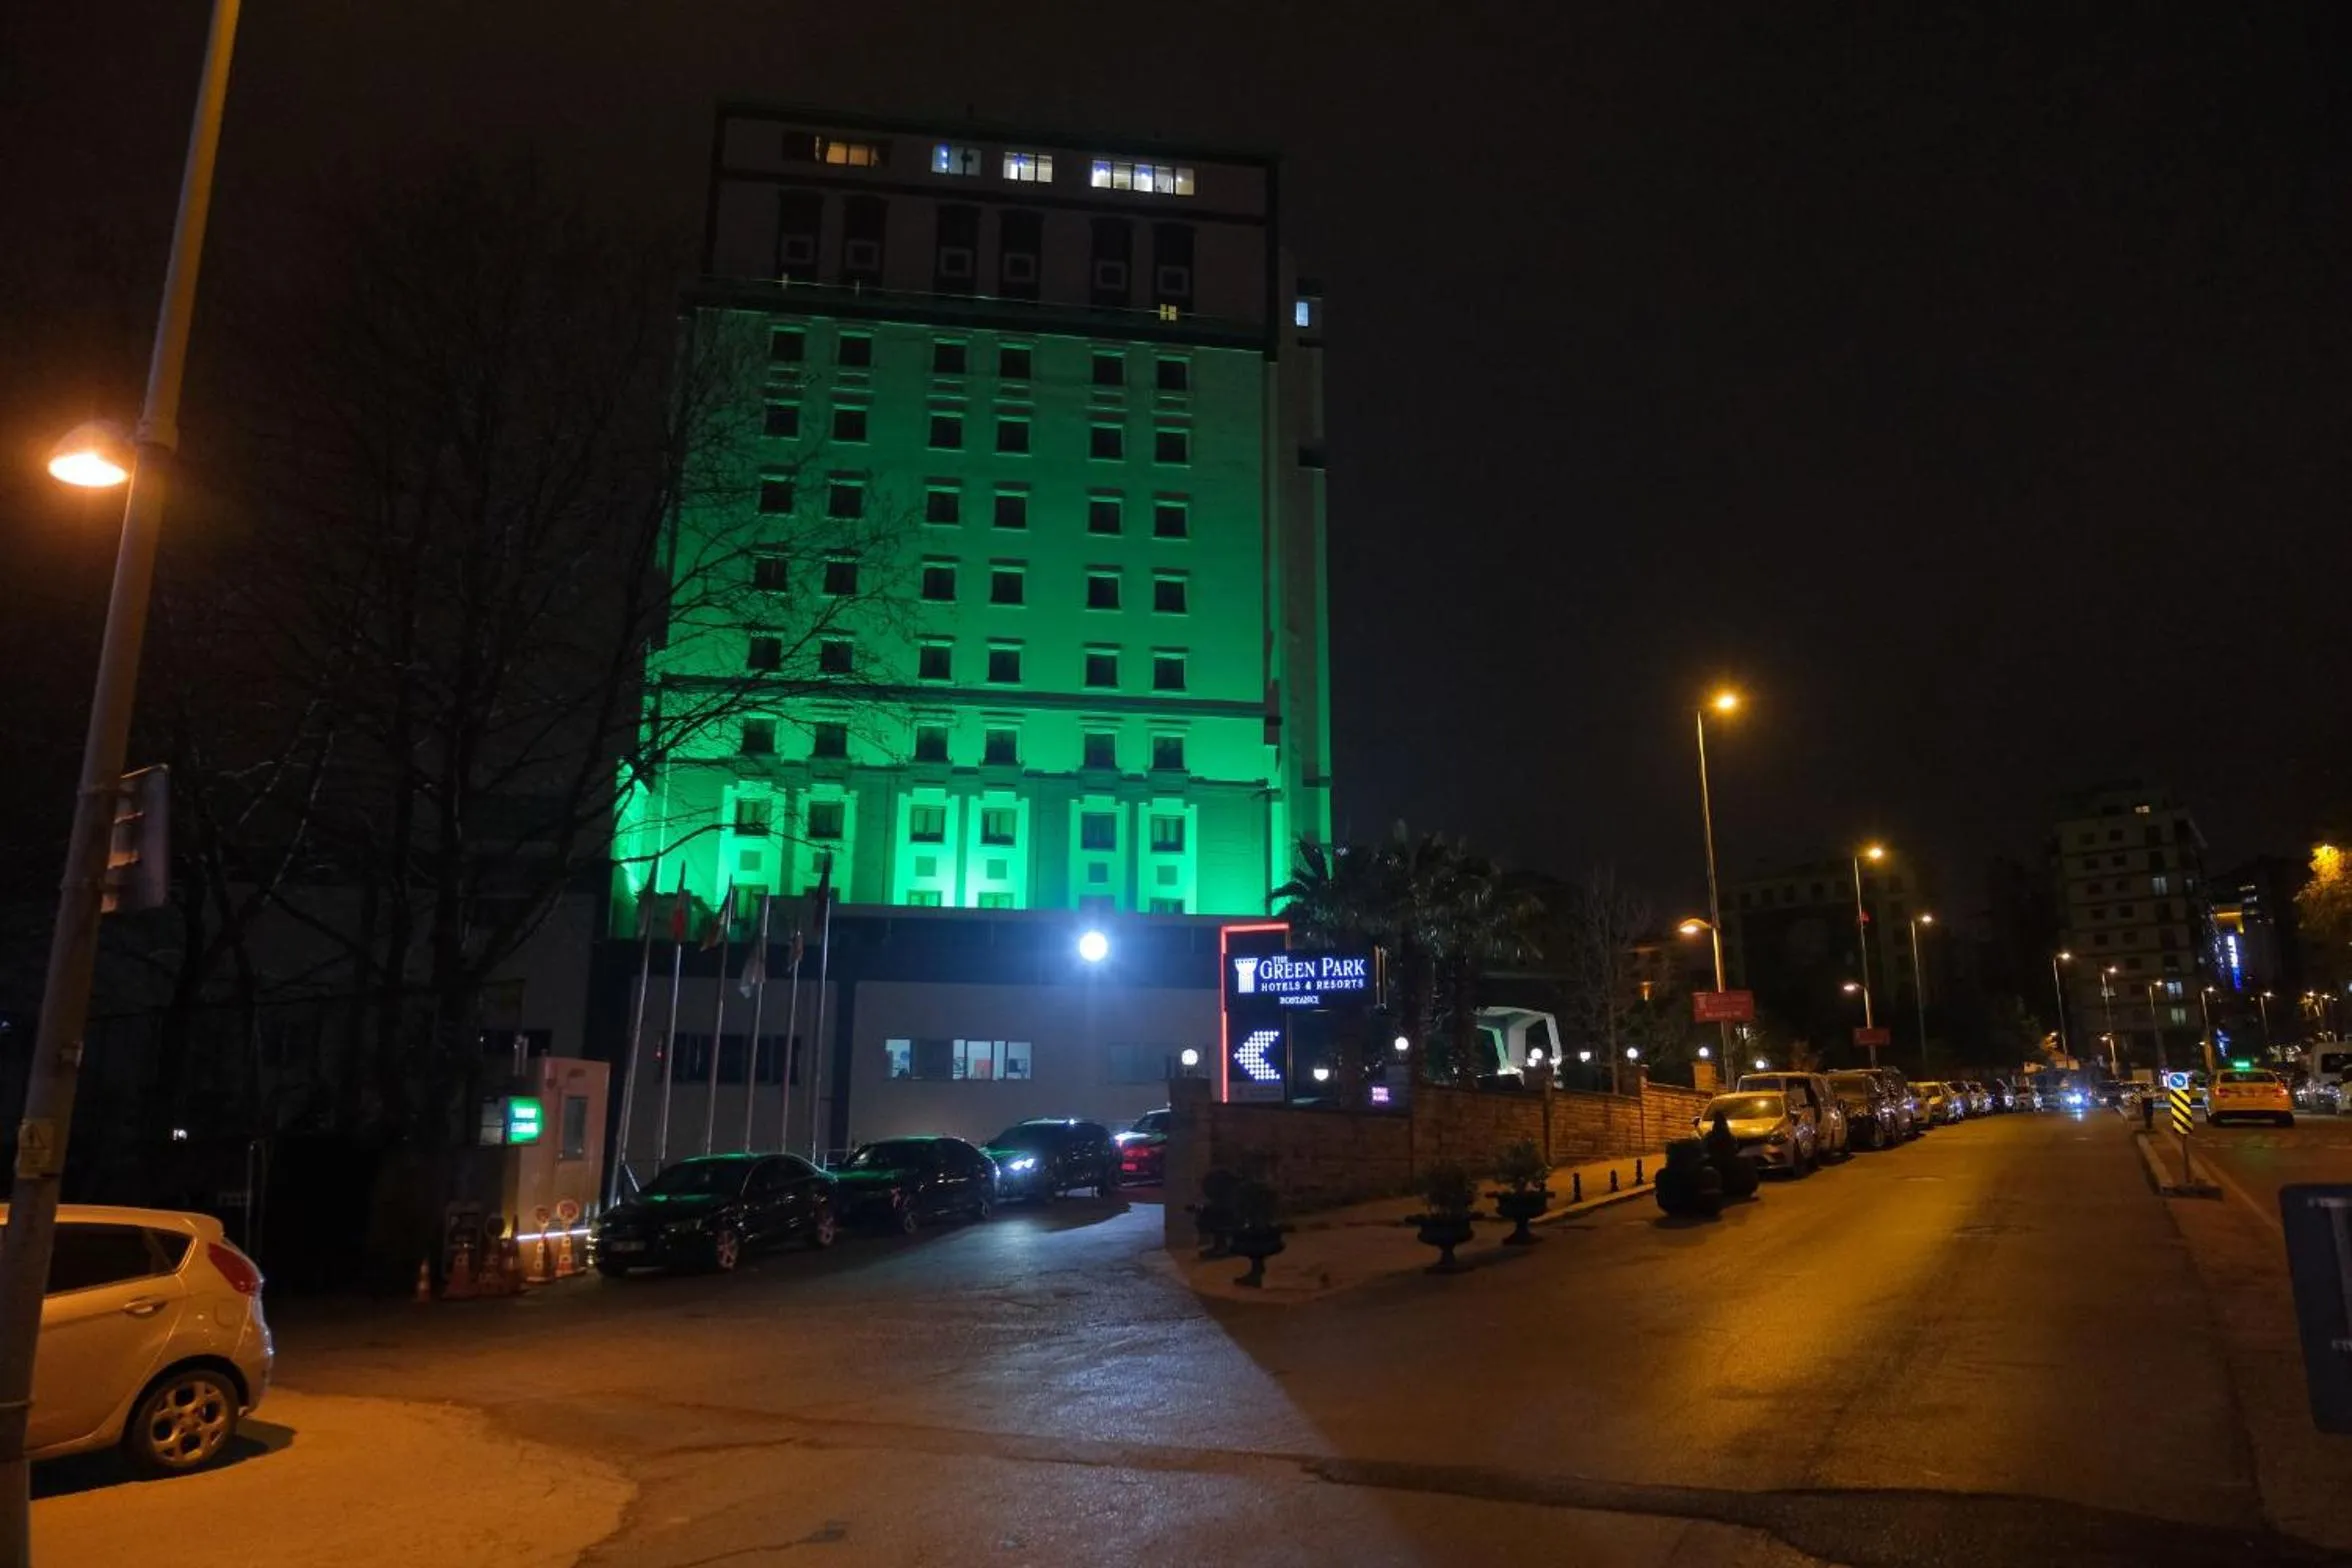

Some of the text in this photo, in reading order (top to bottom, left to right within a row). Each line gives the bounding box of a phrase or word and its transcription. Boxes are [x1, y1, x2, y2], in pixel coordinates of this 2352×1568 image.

[1260, 957, 1366, 979] GREEN PARK
[1261, 979, 1364, 992] HOTELS & RESORTS
